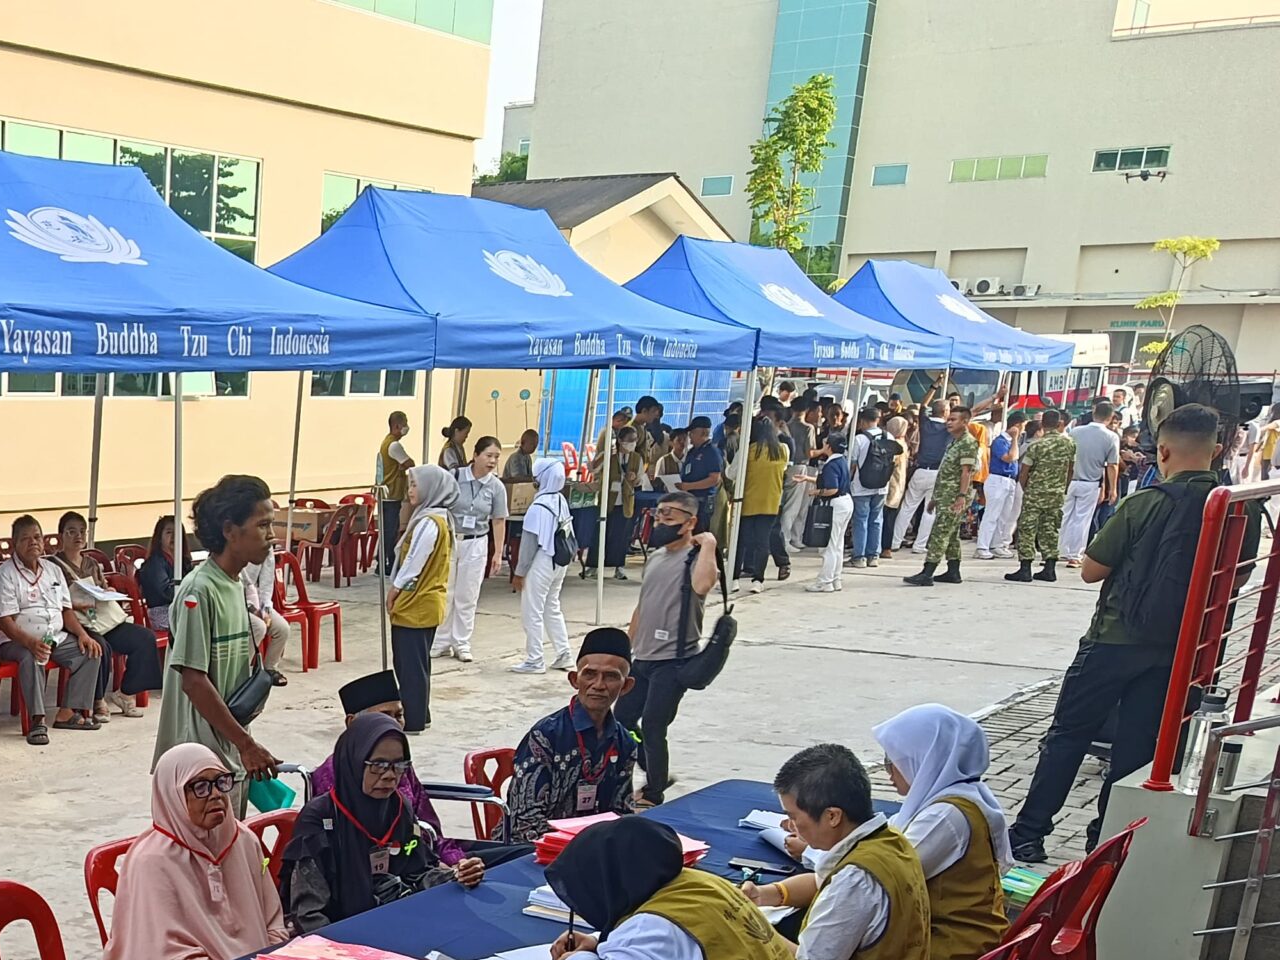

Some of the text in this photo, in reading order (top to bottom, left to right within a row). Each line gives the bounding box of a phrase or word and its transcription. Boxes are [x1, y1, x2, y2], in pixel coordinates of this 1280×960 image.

[0, 319, 330, 363] Yayasan Buddha Tzu Chi Indonesia
[574, 333, 606, 356] Buddha
[616, 334, 631, 356] Tzu
[640, 335, 657, 357] Chi
